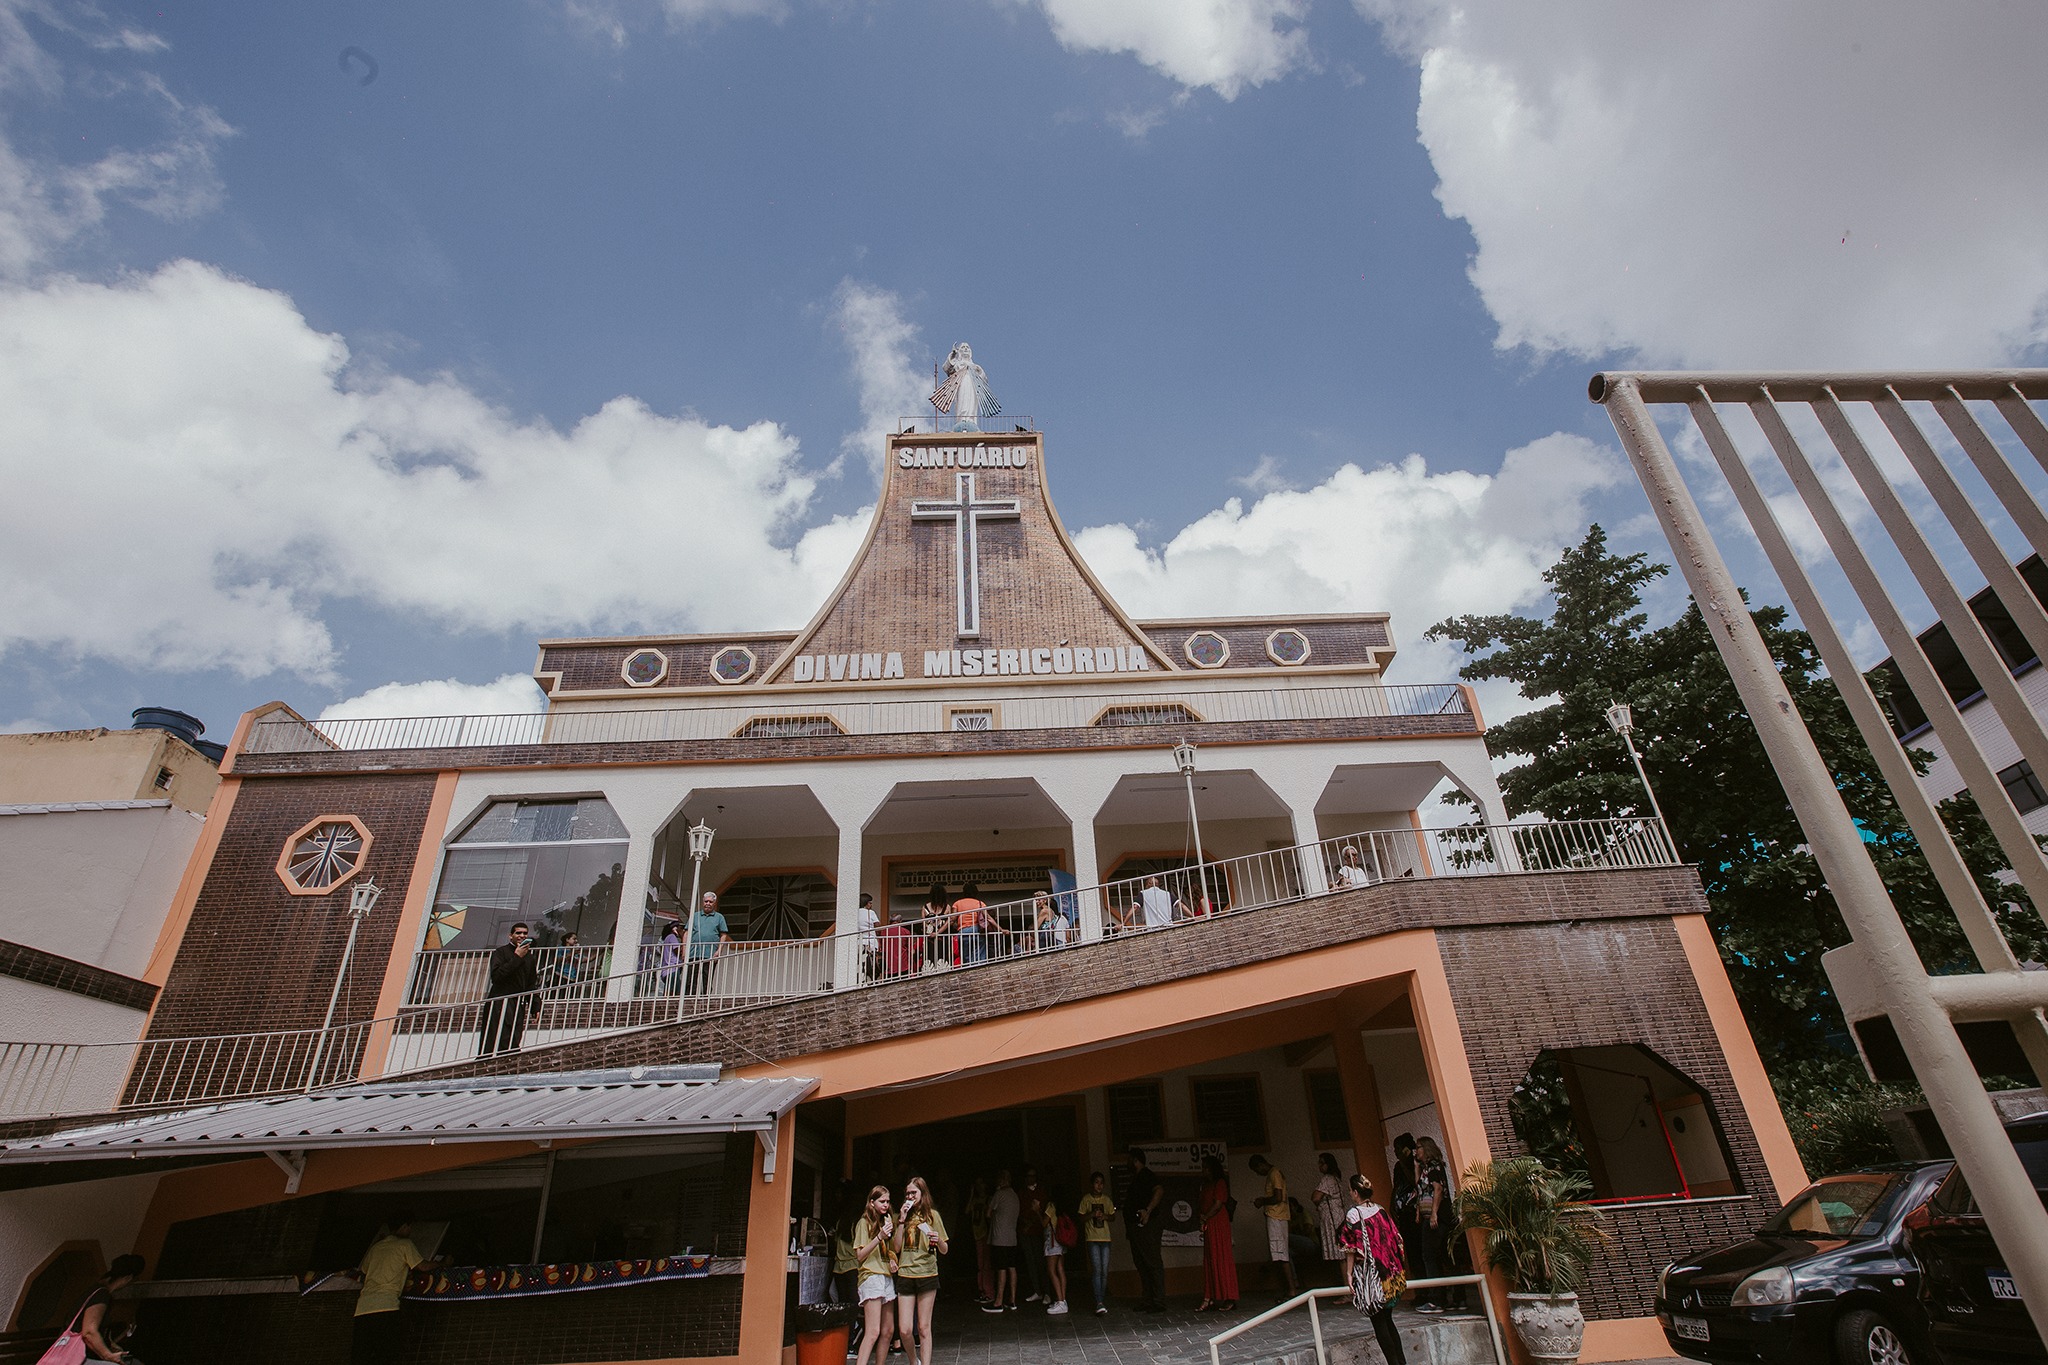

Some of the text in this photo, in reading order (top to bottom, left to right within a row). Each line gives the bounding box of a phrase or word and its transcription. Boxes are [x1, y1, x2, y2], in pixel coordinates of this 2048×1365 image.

[899, 443, 1027, 469] SANTUÁRIO
[793, 639, 1149, 683] DIVINA MISERICÓRDIA
[1190, 1143, 1225, 1163] 95%
